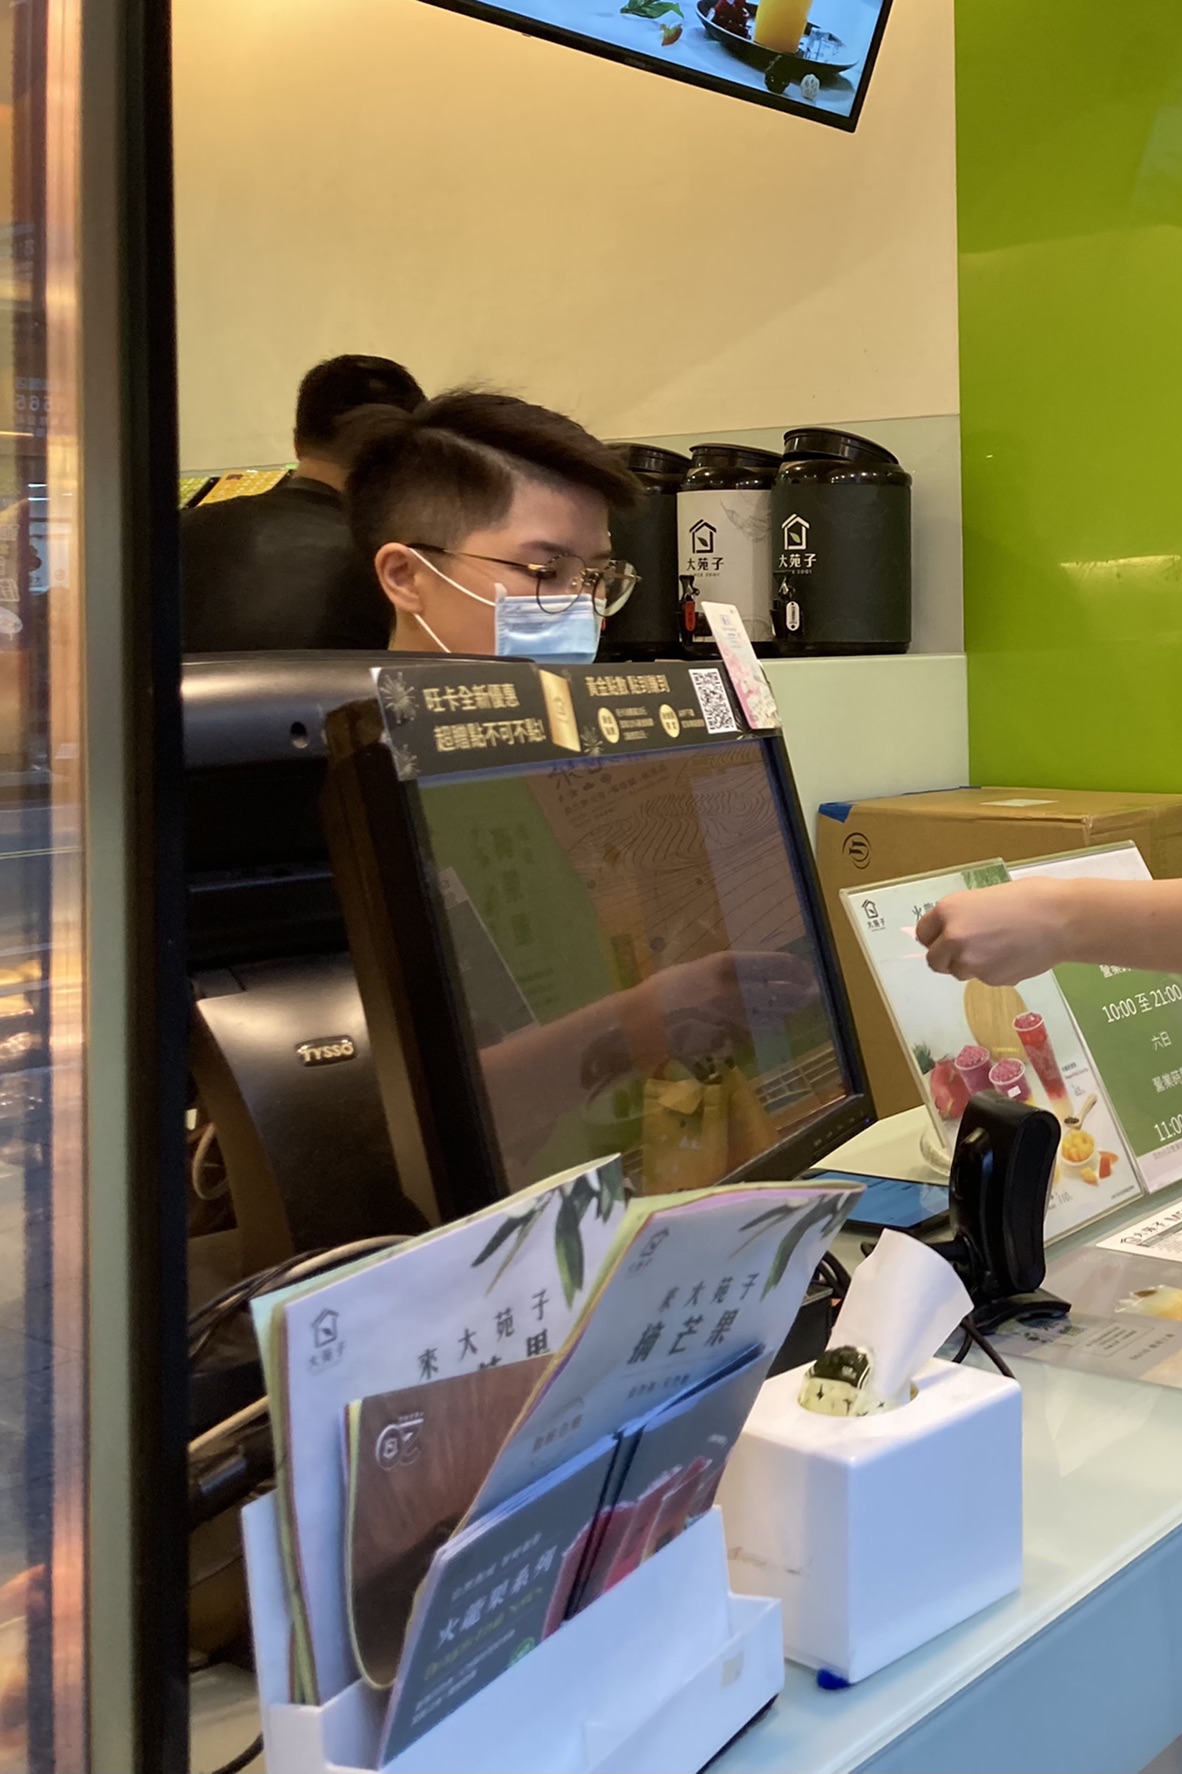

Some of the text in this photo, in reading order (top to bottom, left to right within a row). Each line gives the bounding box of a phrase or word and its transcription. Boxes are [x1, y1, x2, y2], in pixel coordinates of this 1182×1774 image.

[687, 557, 724, 571] 大苑子
[778, 554, 816, 568] 大苑子
[1102, 984, 1182, 1023] 10:00 至 21:00
[1151, 1031, 1172, 1051] 六日
[418, 1289, 549, 1381] 來大苑子
